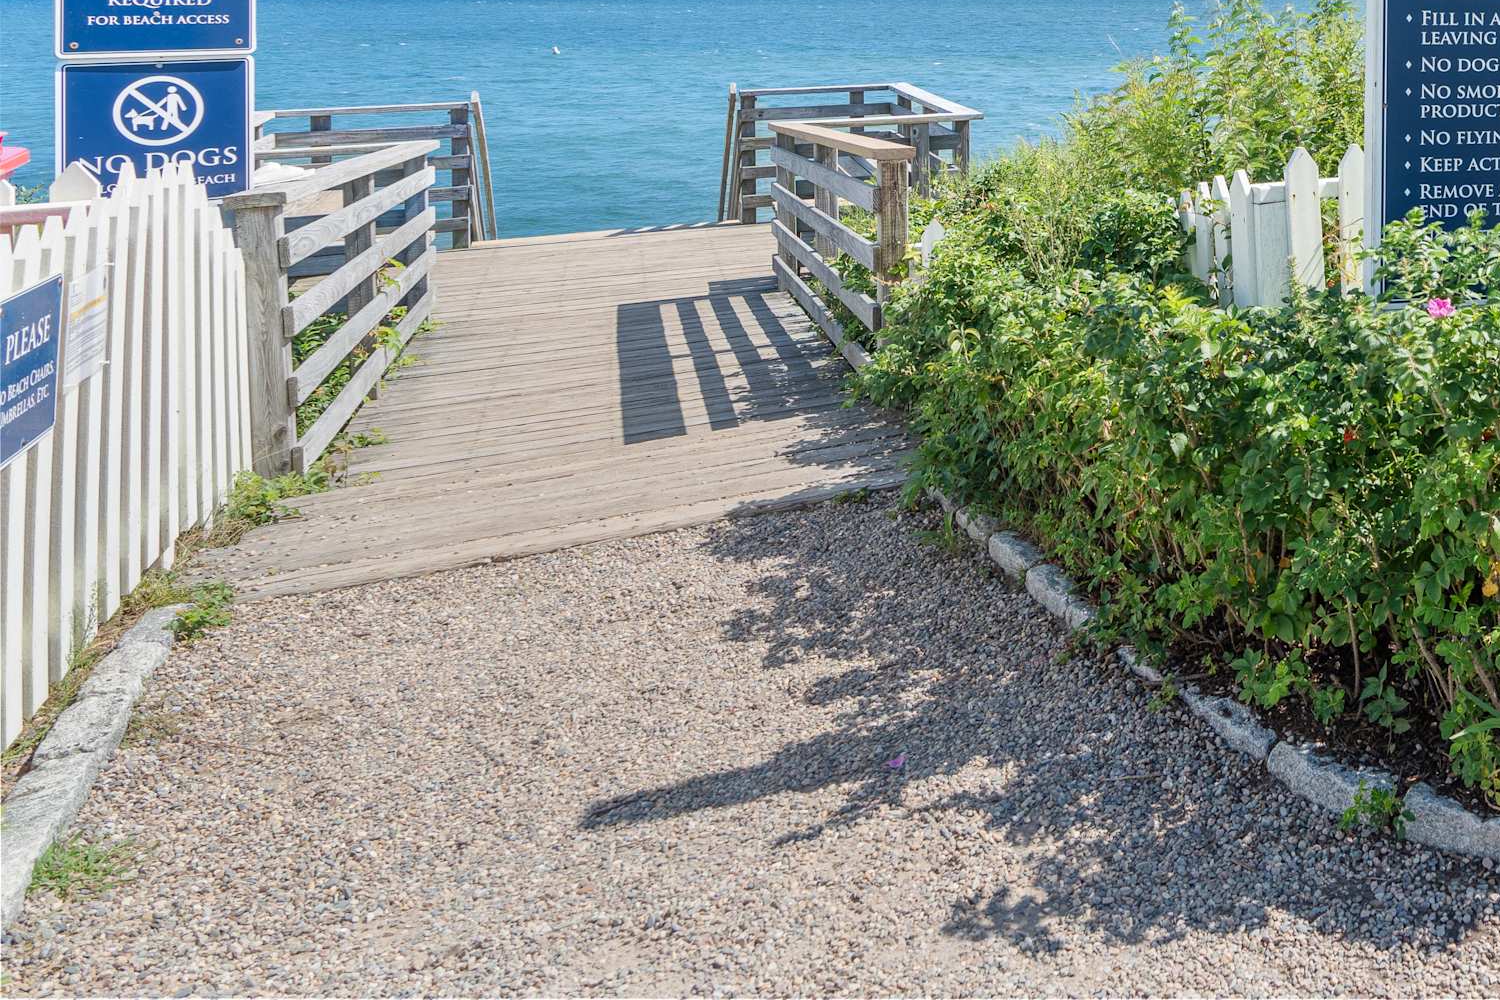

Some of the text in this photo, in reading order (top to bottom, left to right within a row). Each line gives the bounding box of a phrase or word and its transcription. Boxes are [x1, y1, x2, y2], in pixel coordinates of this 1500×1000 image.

[87, 14, 230, 26] FOR BEACH ACCESS
[1421, 9, 1459, 26] FILL
[1464, 12, 1485, 26] IN
[1421, 30, 1497, 46] LEAVING
[1420, 56, 1452, 73] NO
[1420, 83, 1452, 100] NO
[1419, 129, 1451, 146] NO
[79, 147, 238, 175] NO DOGS
[1420, 156, 1463, 173] KEEP
[1419, 183, 1495, 200] REMOVE
[1420, 203, 1458, 219] END
[5, 315, 51, 365] PLEASE
[8, 375, 29, 402] BEACH
